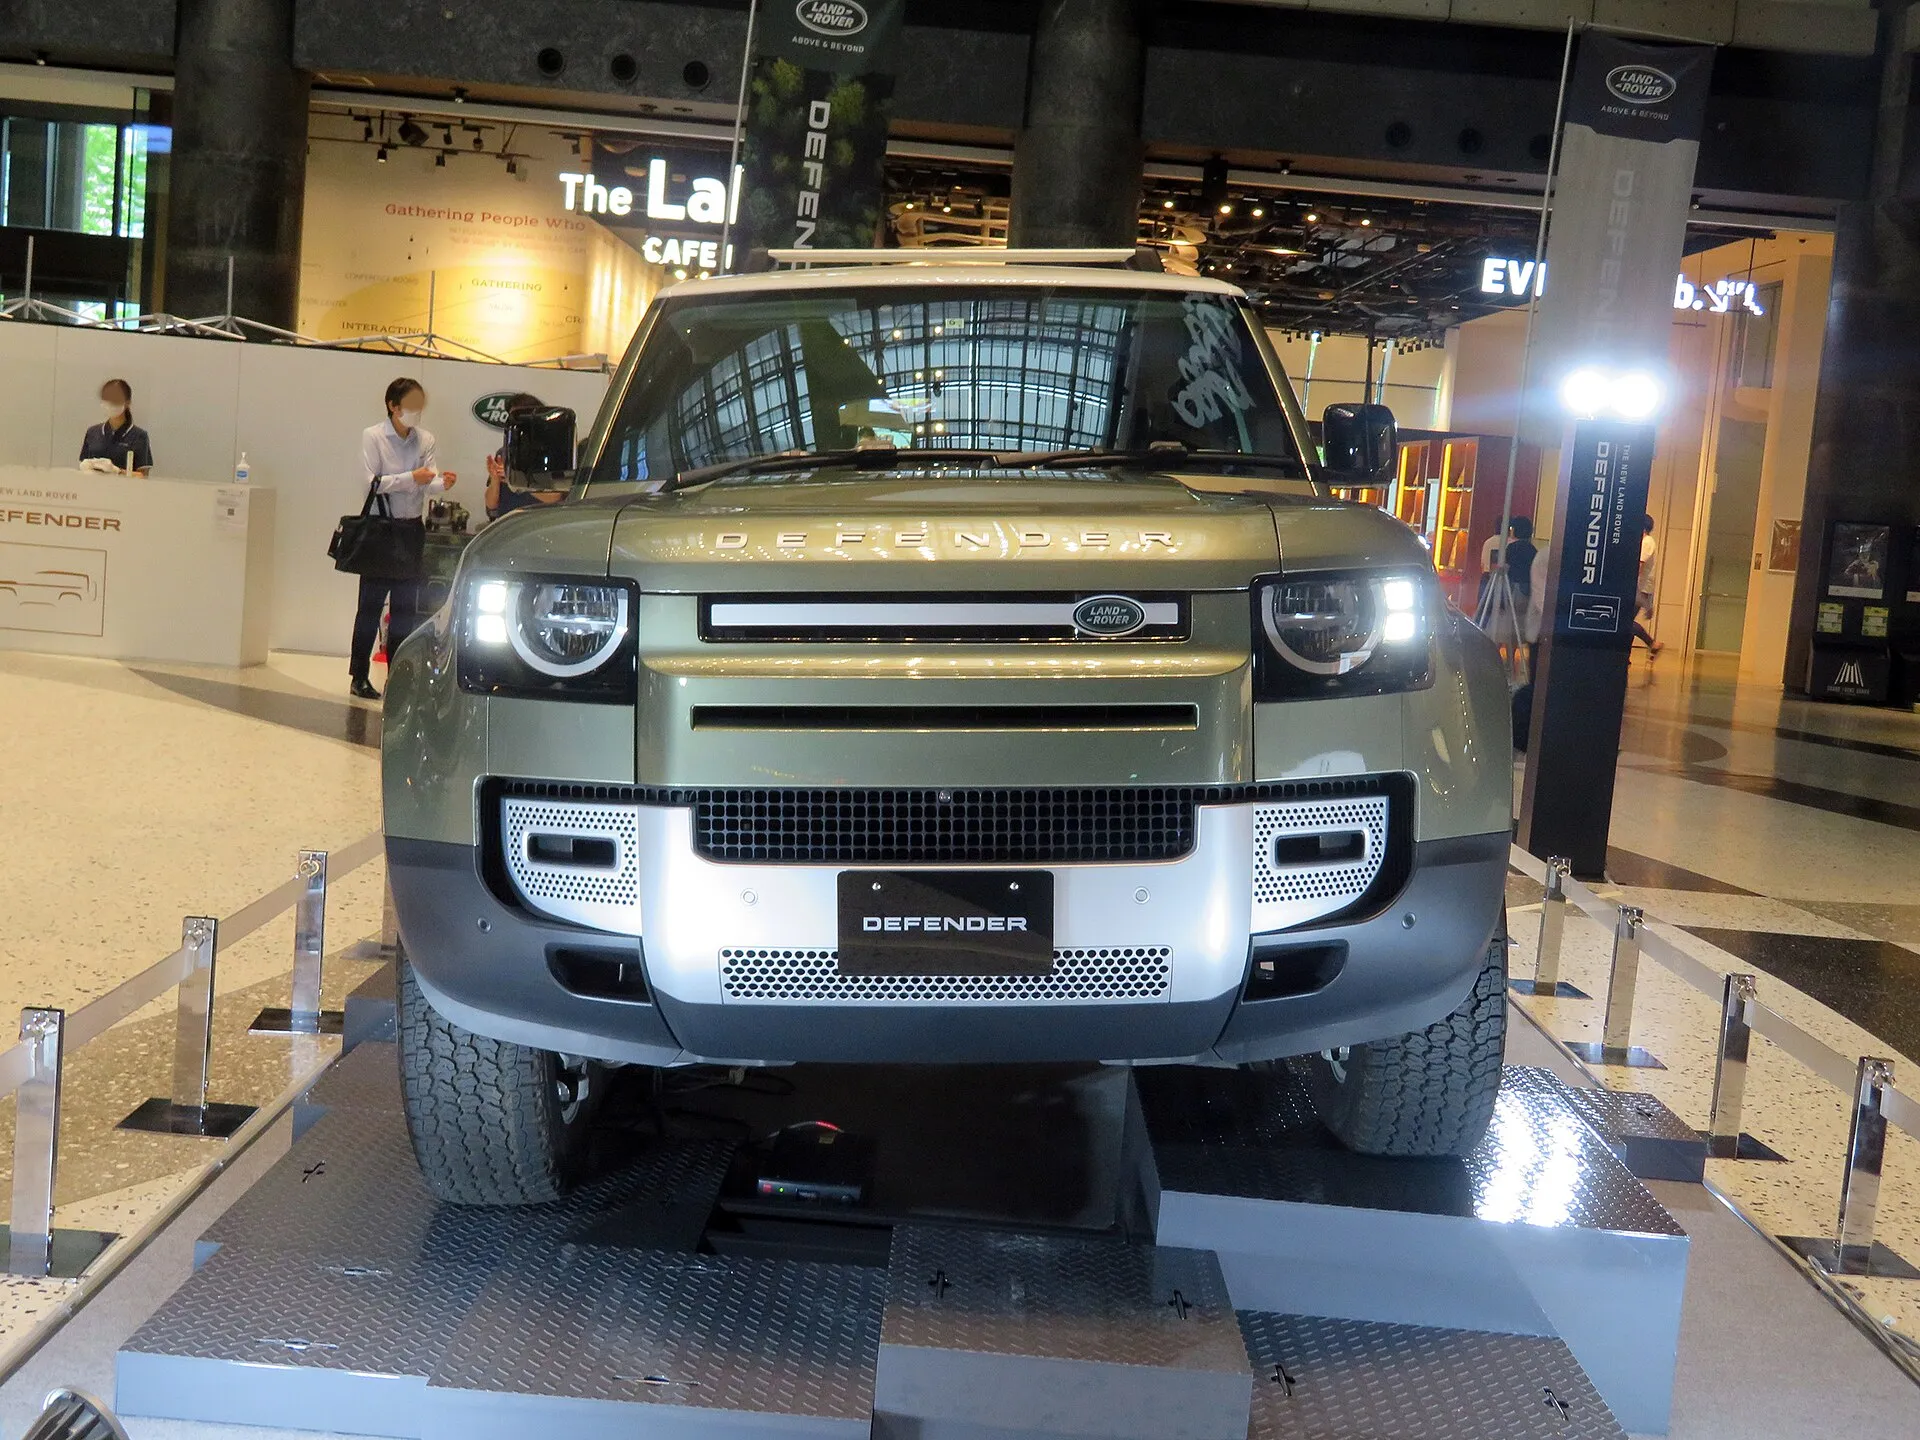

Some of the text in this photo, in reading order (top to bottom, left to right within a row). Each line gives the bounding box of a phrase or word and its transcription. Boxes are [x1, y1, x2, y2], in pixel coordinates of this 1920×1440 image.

[811, 1, 846, 16] LAND
[812, 13, 854, 28] ROVER
[792, 36, 820, 47] ABOVE
[830, 42, 865, 53] BEYOND
[1620, 72, 1654, 85] LAND
[1621, 82, 1663, 96] ROVER
[1601, 105, 1629, 115] ABOVE
[559, 172, 633, 216] The
[385, 203, 586, 231] Gathering People Who
[642, 236, 718, 269] CAFE
[471, 278, 542, 292] GATHERING
[342, 321, 425, 335] INTERACTING
[1619, 464, 1629, 484] NEW
[17, 489, 42, 498] LAND
[46, 492, 78, 500] ROVER
[1616, 486, 1626, 512] LAND
[1581, 441, 1611, 584] DEFENDER
[1611, 512, 1623, 545] ROVER
[715, 530, 1175, 549] DEFENDER
[1090, 606, 1120, 616] LAND
[1092, 615, 1130, 625] ROVER
[862, 916, 1028, 931] DEFENDER
